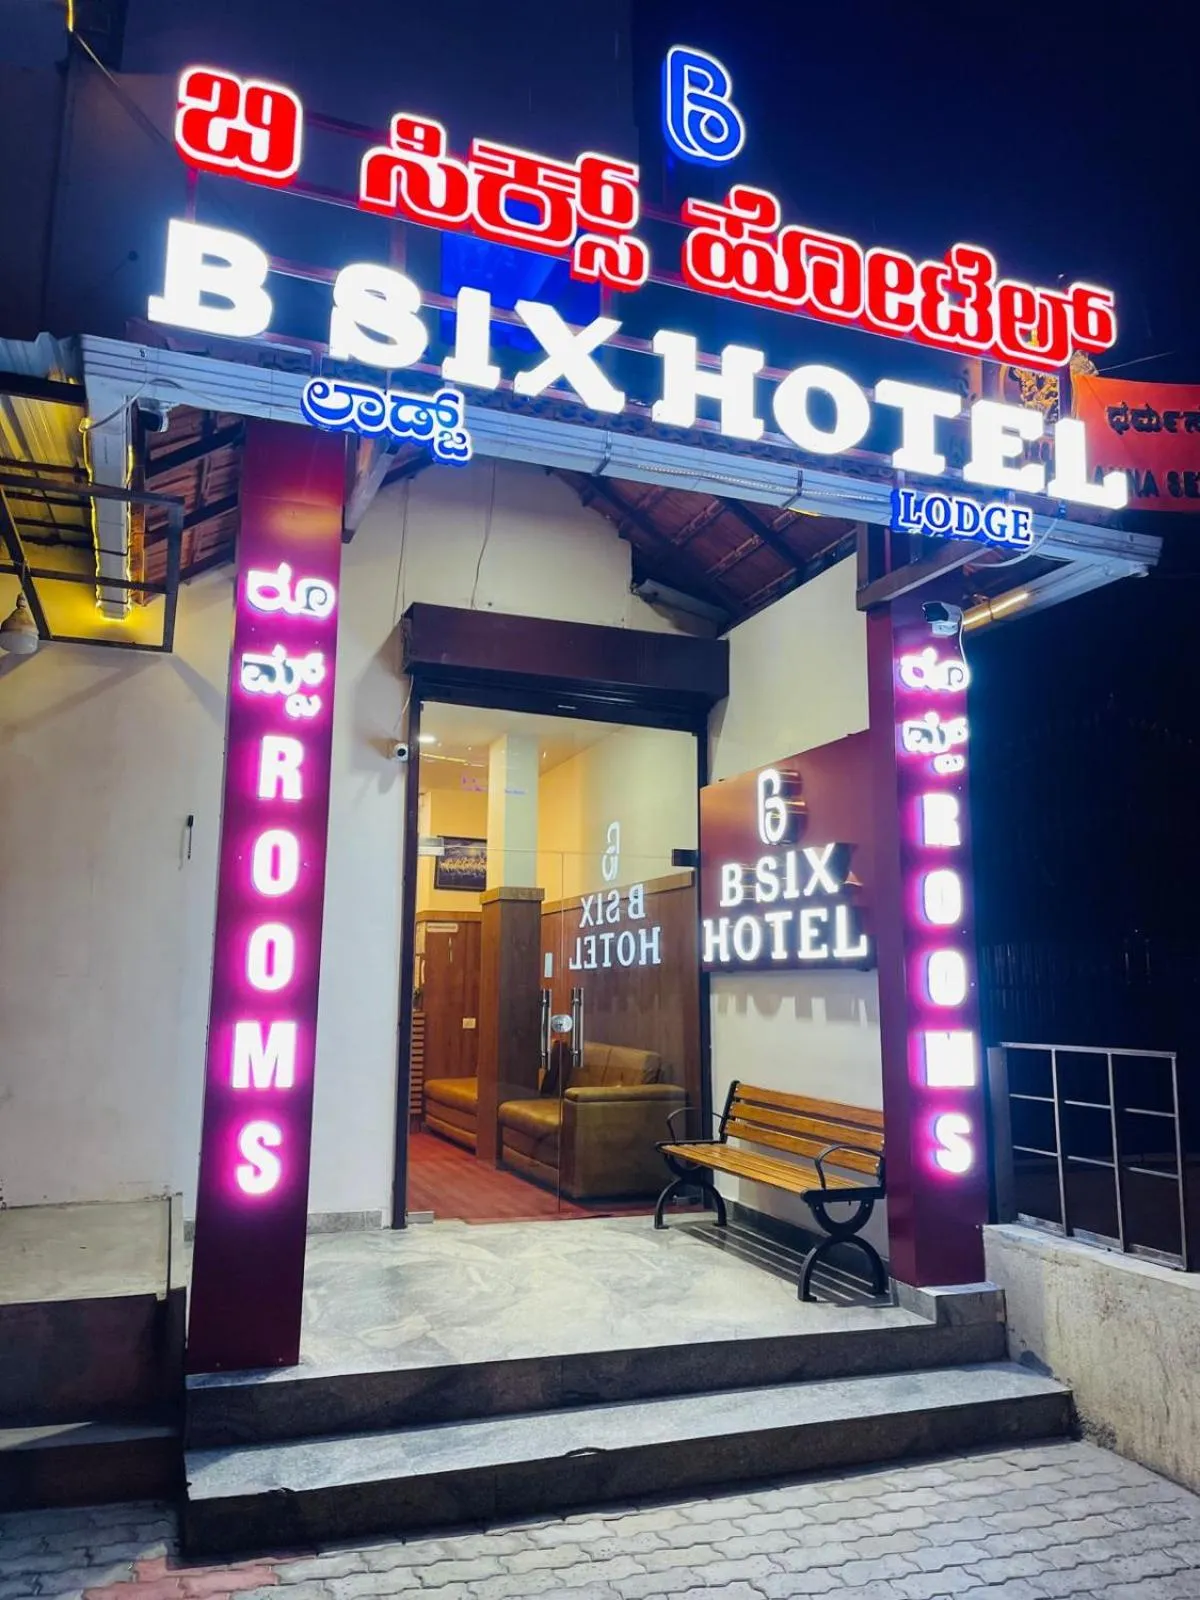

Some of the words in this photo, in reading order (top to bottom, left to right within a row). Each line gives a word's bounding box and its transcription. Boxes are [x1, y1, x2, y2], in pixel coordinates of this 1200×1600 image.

[147, 218, 274, 339] B
[328, 262, 626, 415] SIX
[651, 329, 1129, 511] HOTEL
[175, 66, 304, 186] ಬಿ
[358, 112, 650, 292] ಸಿಕ್ಸ್
[681, 184, 1118, 371] ಹೋಟೆಲ್
[301, 377, 474, 466] ಲಾಡ್ಜ್
[892, 487, 1034, 548] LODGE
[230, 734, 305, 1196] ROOMS
[703, 905, 869, 963] HOTEL
[922, 792, 977, 1173] ROOMS
